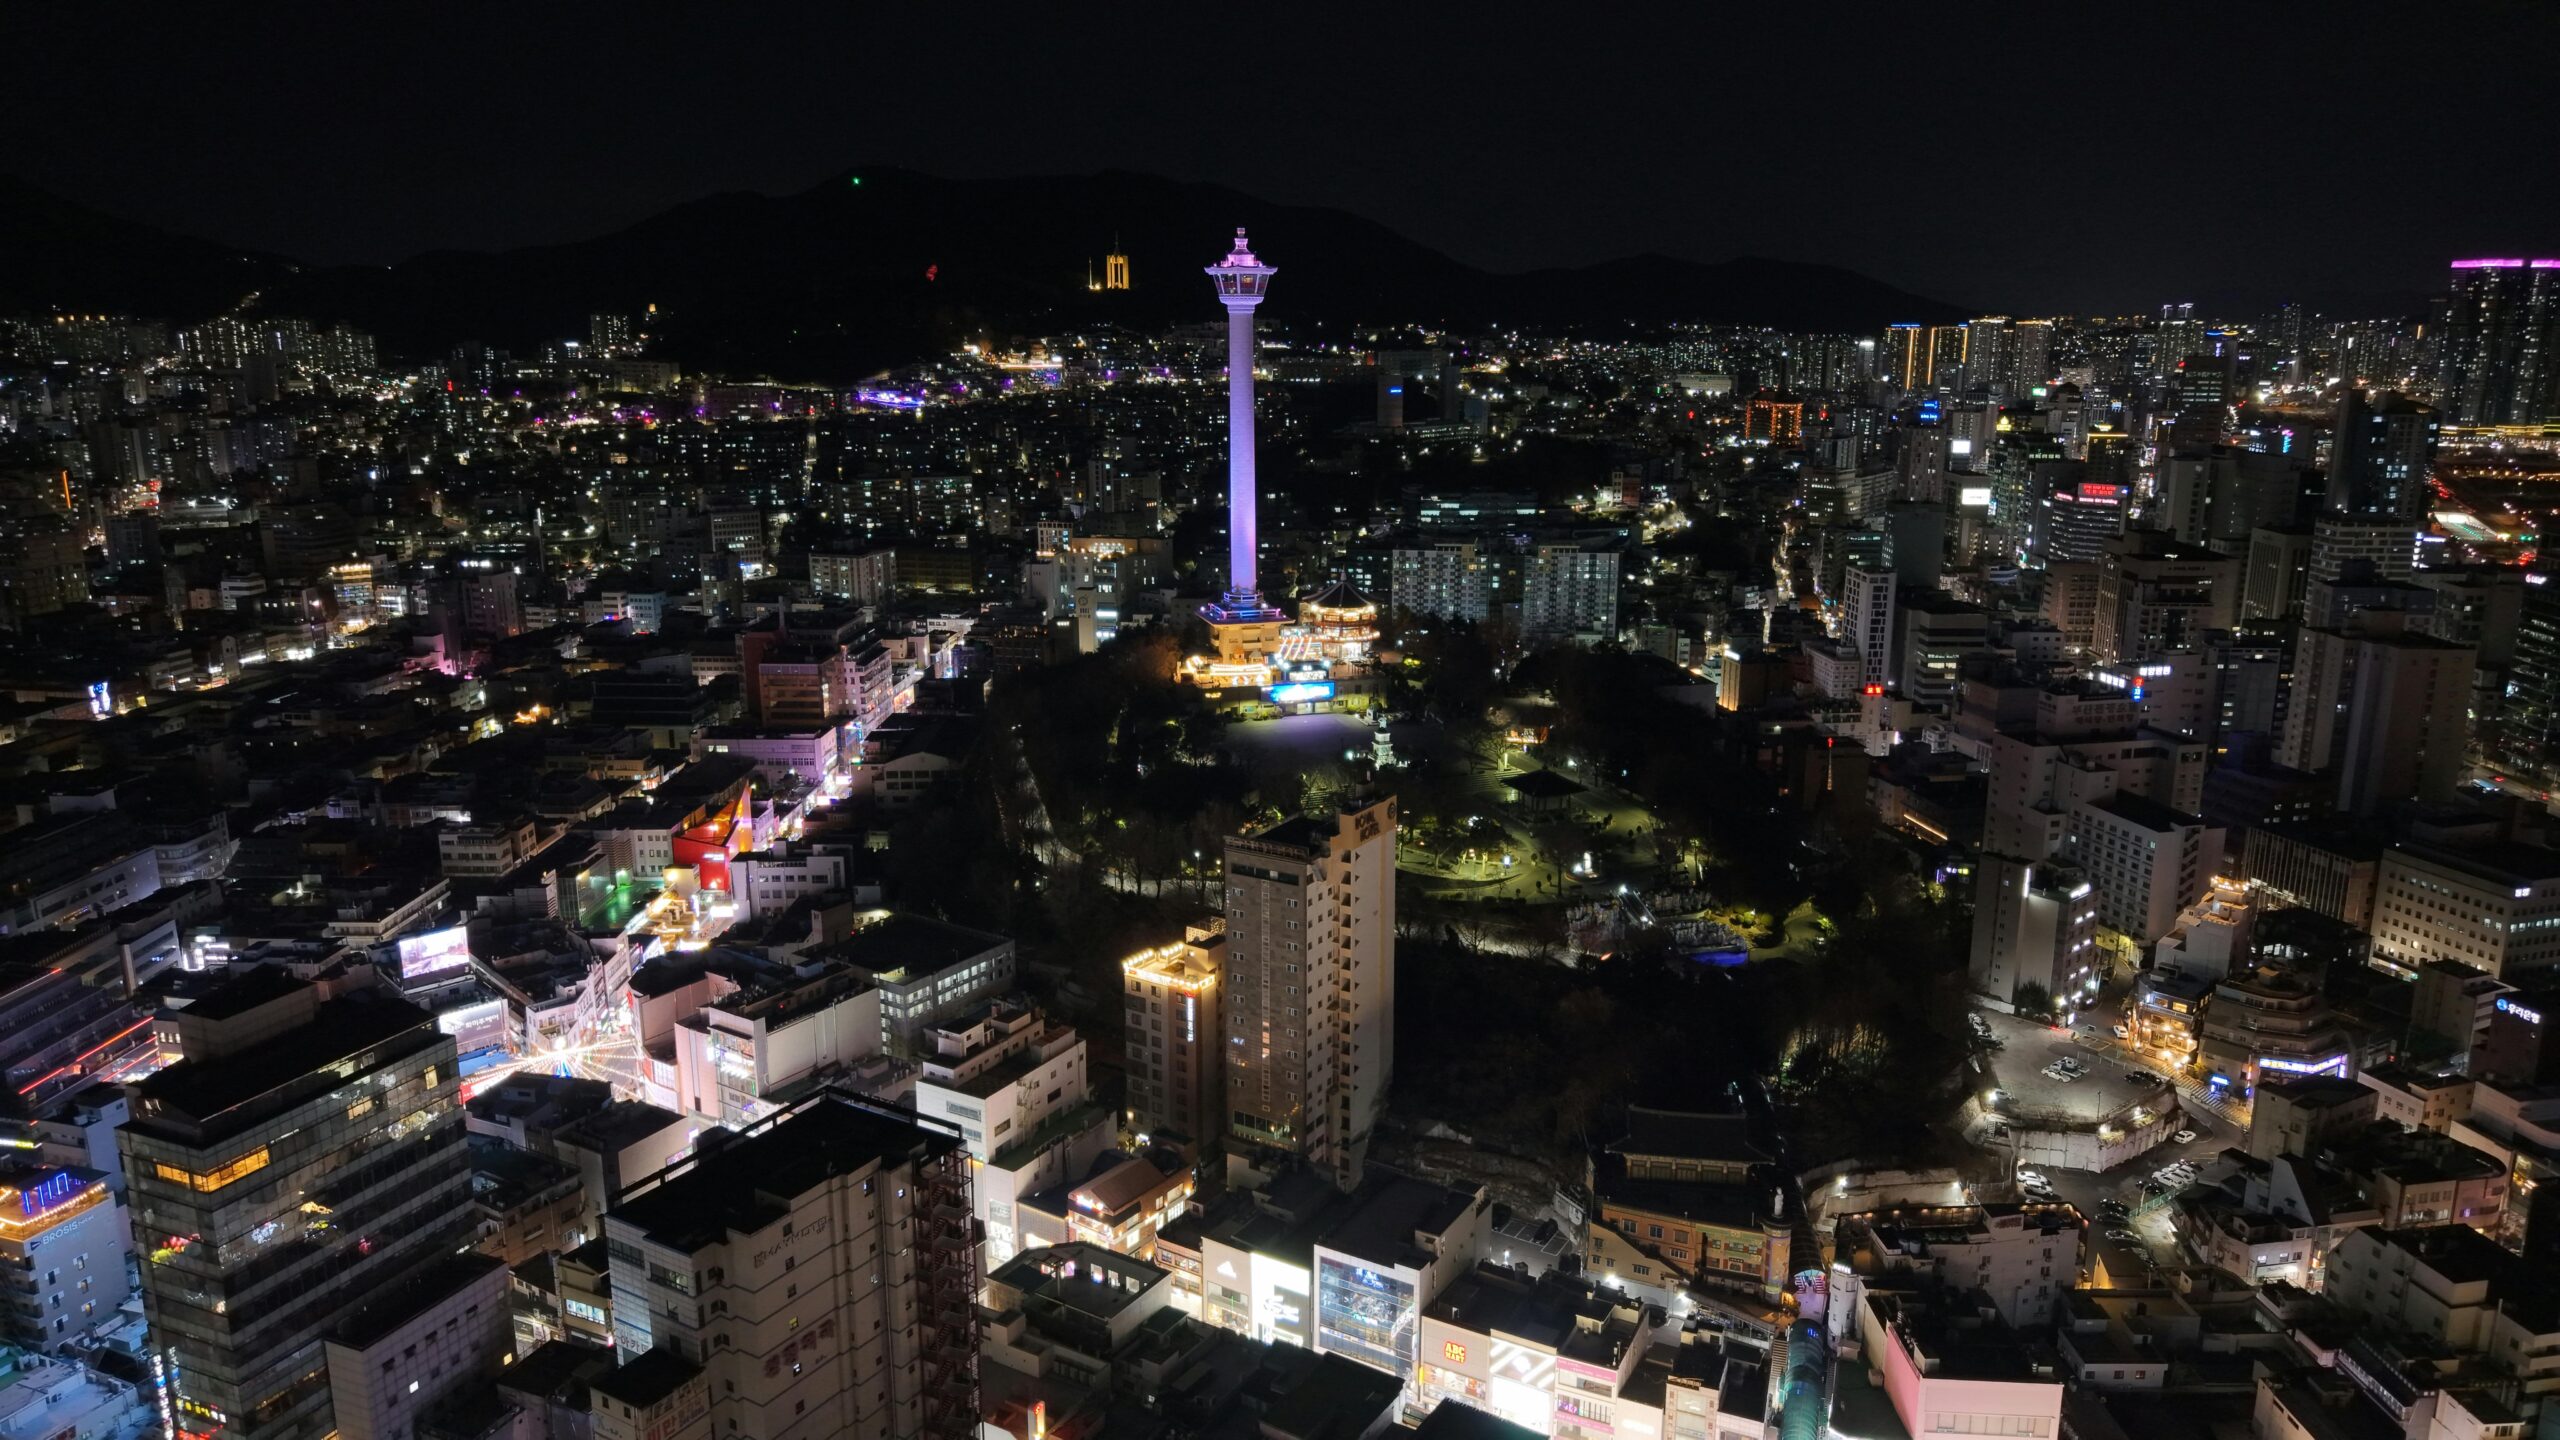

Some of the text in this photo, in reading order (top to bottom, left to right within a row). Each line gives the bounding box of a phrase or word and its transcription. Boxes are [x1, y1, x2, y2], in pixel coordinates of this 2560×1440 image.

[1360, 822, 1381, 842] HOTEL
[2507, 1003, 2541, 1024] 우리은행
[43, 1221, 78, 1245] BROSIS
[1445, 1342, 1465, 1357] ABC
[1445, 1351, 1465, 1364] MART
